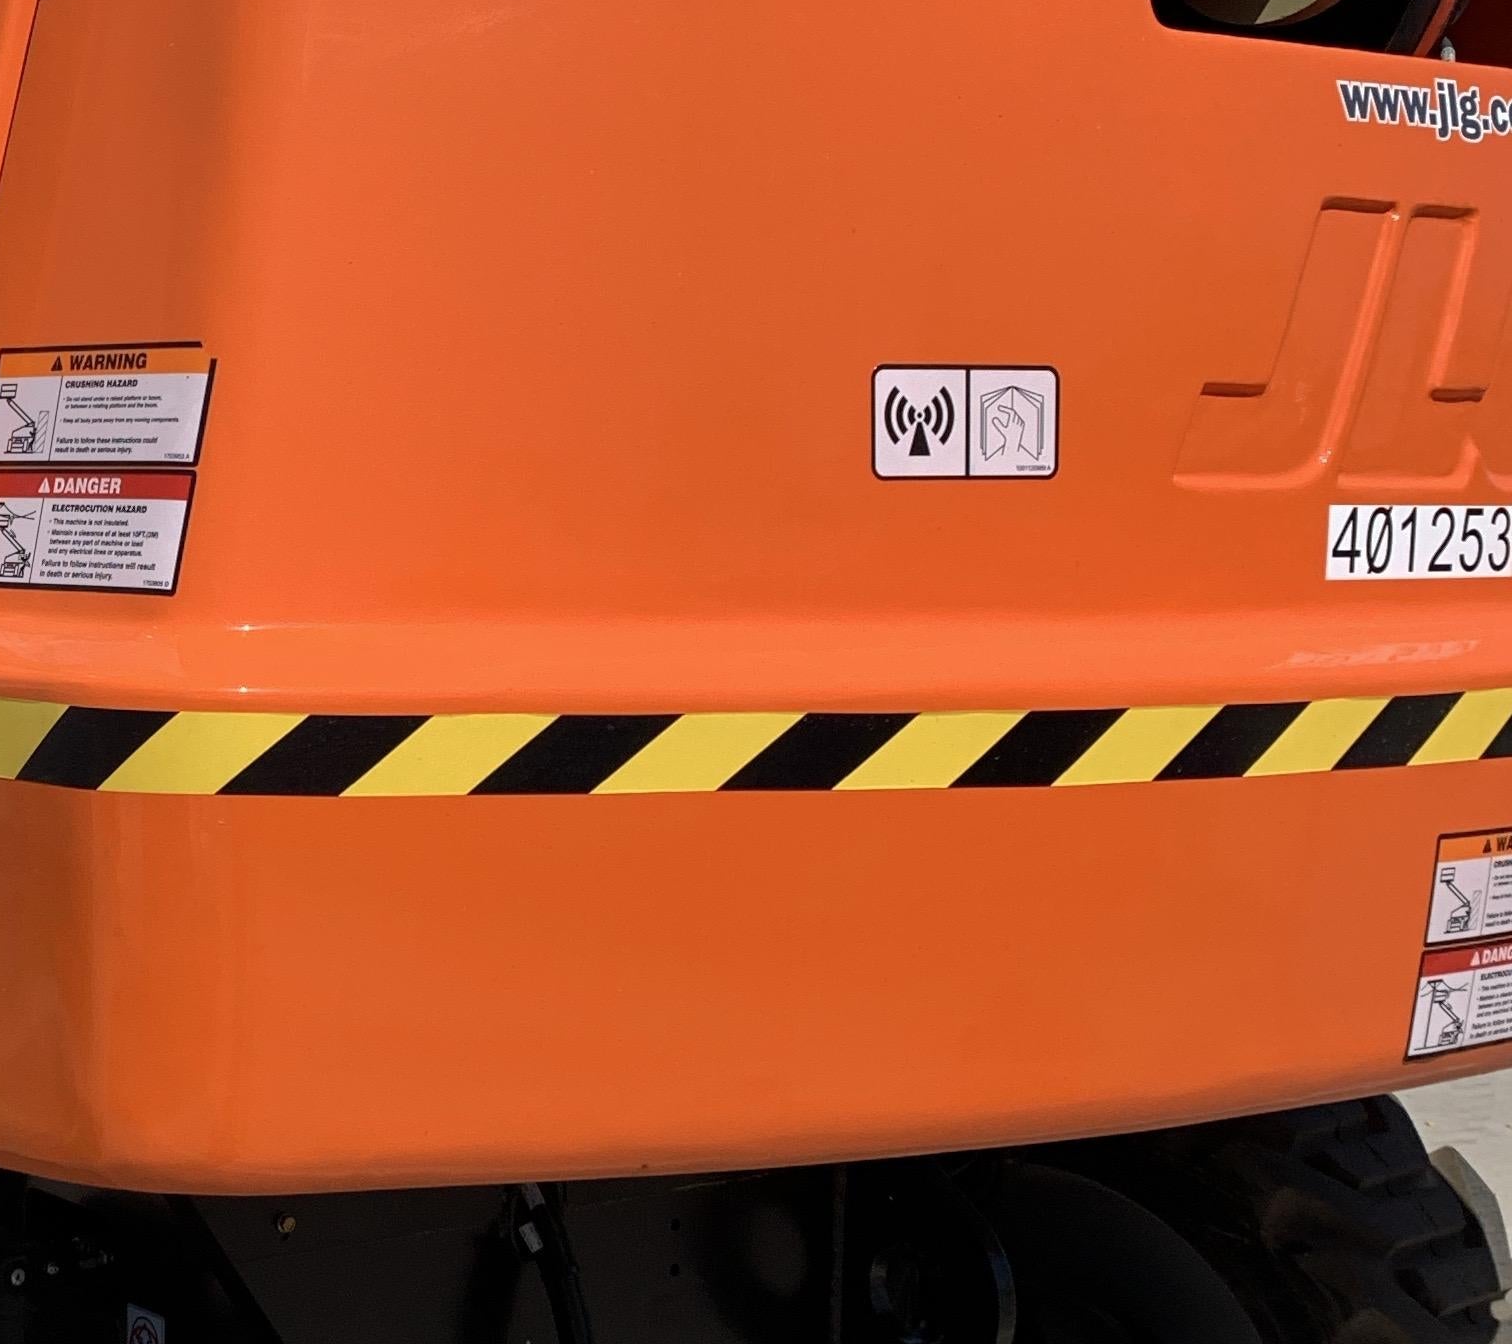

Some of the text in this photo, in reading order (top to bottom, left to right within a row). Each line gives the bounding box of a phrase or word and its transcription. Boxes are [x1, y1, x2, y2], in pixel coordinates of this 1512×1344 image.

[69, 353, 148, 371] WARNING
[65, 379, 138, 389] CRUSHING HAZARD
[53, 477, 122, 494] DANGER
[52, 504, 147, 513] ELECTROCUTION HAZARD
[1331, 506, 1511, 574] 401253
[42, 559, 61, 567] Failure
[70, 560, 87, 568] follow
[89, 561, 123, 569] instructions
[72, 571, 93, 579] serious
[95, 572, 112, 582] injury.
